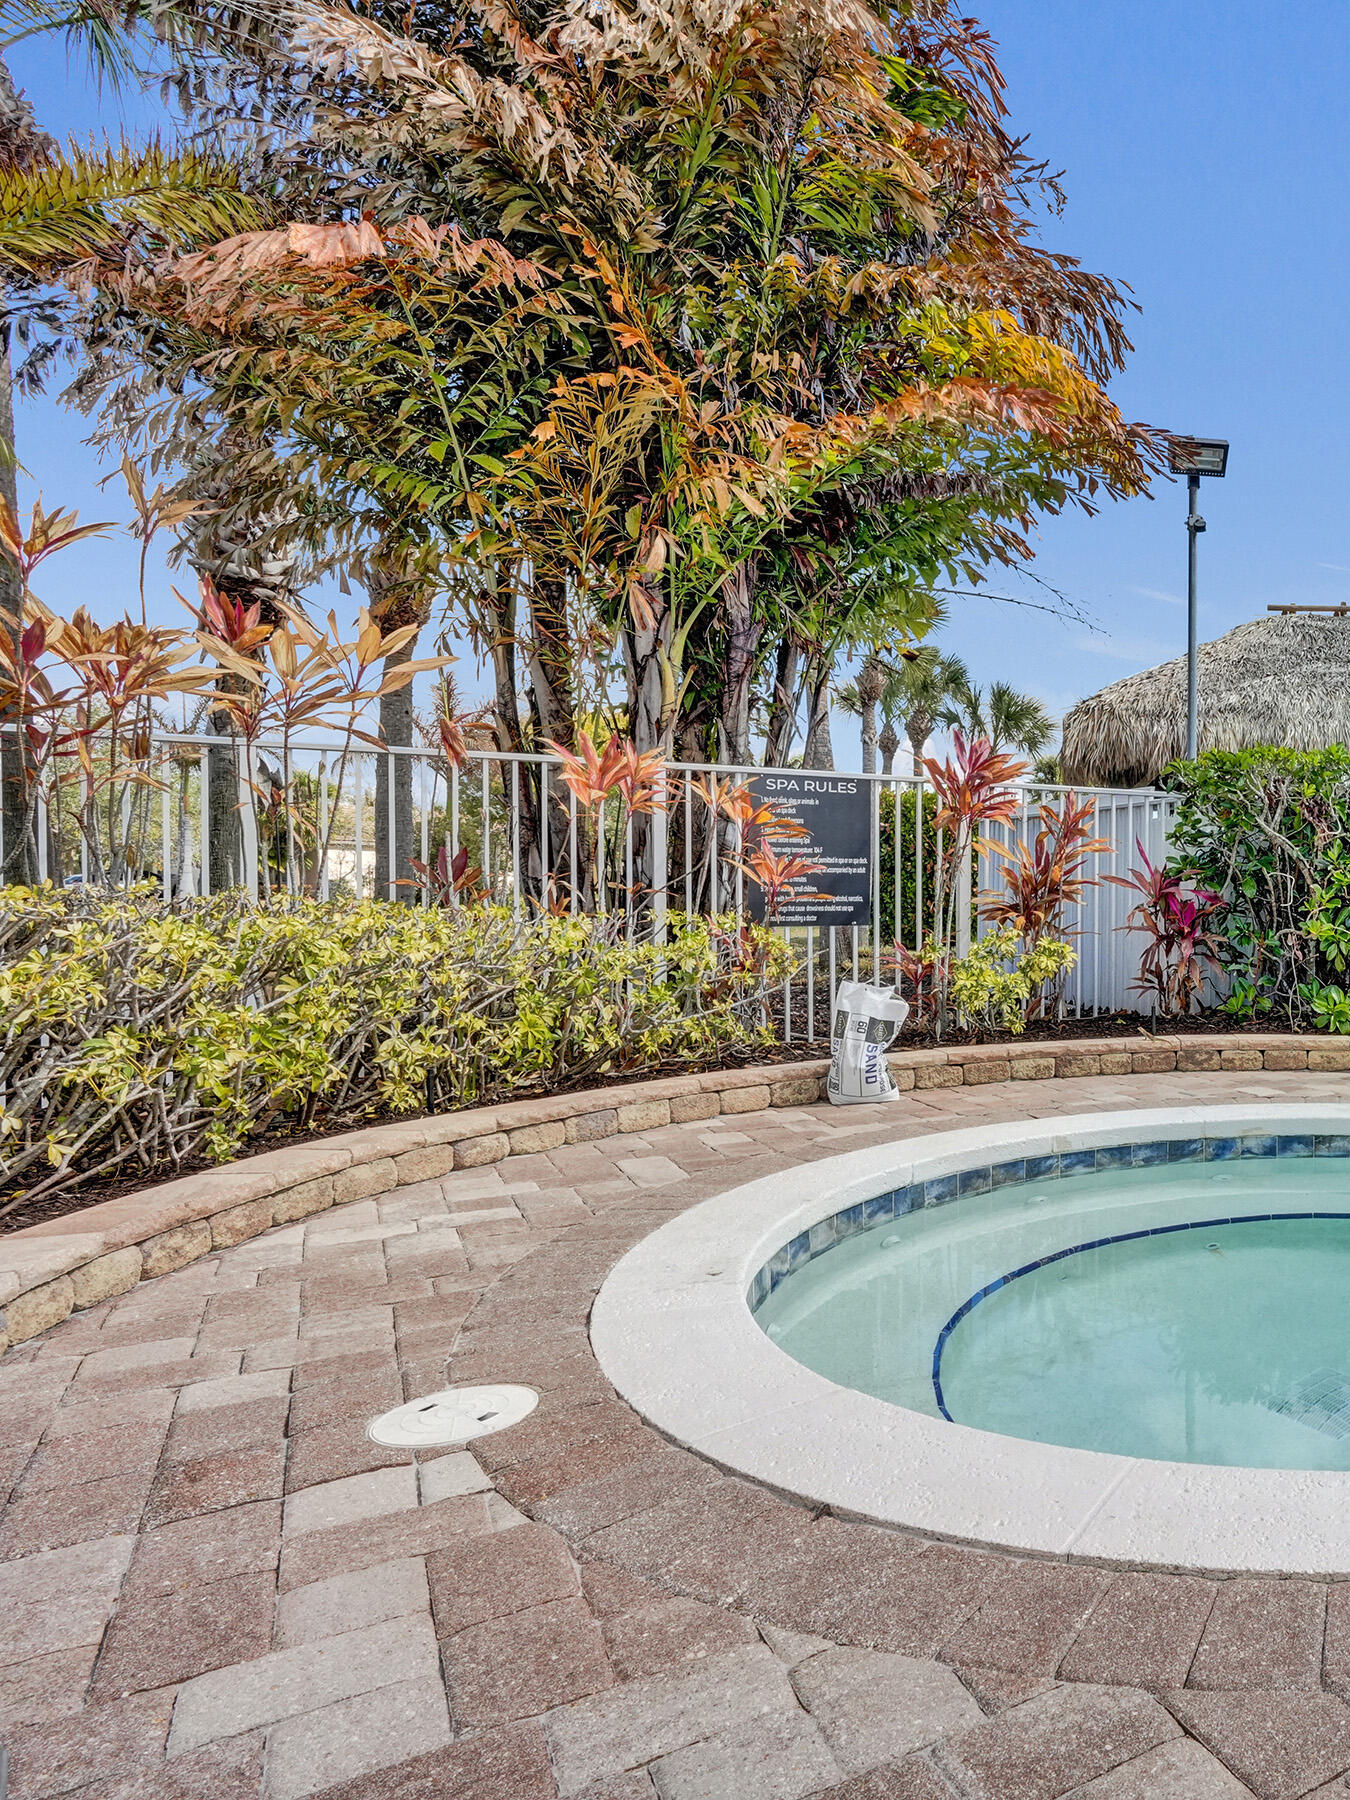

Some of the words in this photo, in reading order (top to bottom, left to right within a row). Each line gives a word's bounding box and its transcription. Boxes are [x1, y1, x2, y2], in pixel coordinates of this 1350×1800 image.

[766, 778, 800, 791] SPA
[804, 780, 857, 794] RULES
[856, 1020, 868, 1034] 60
[865, 1044, 878, 1084] SAND
